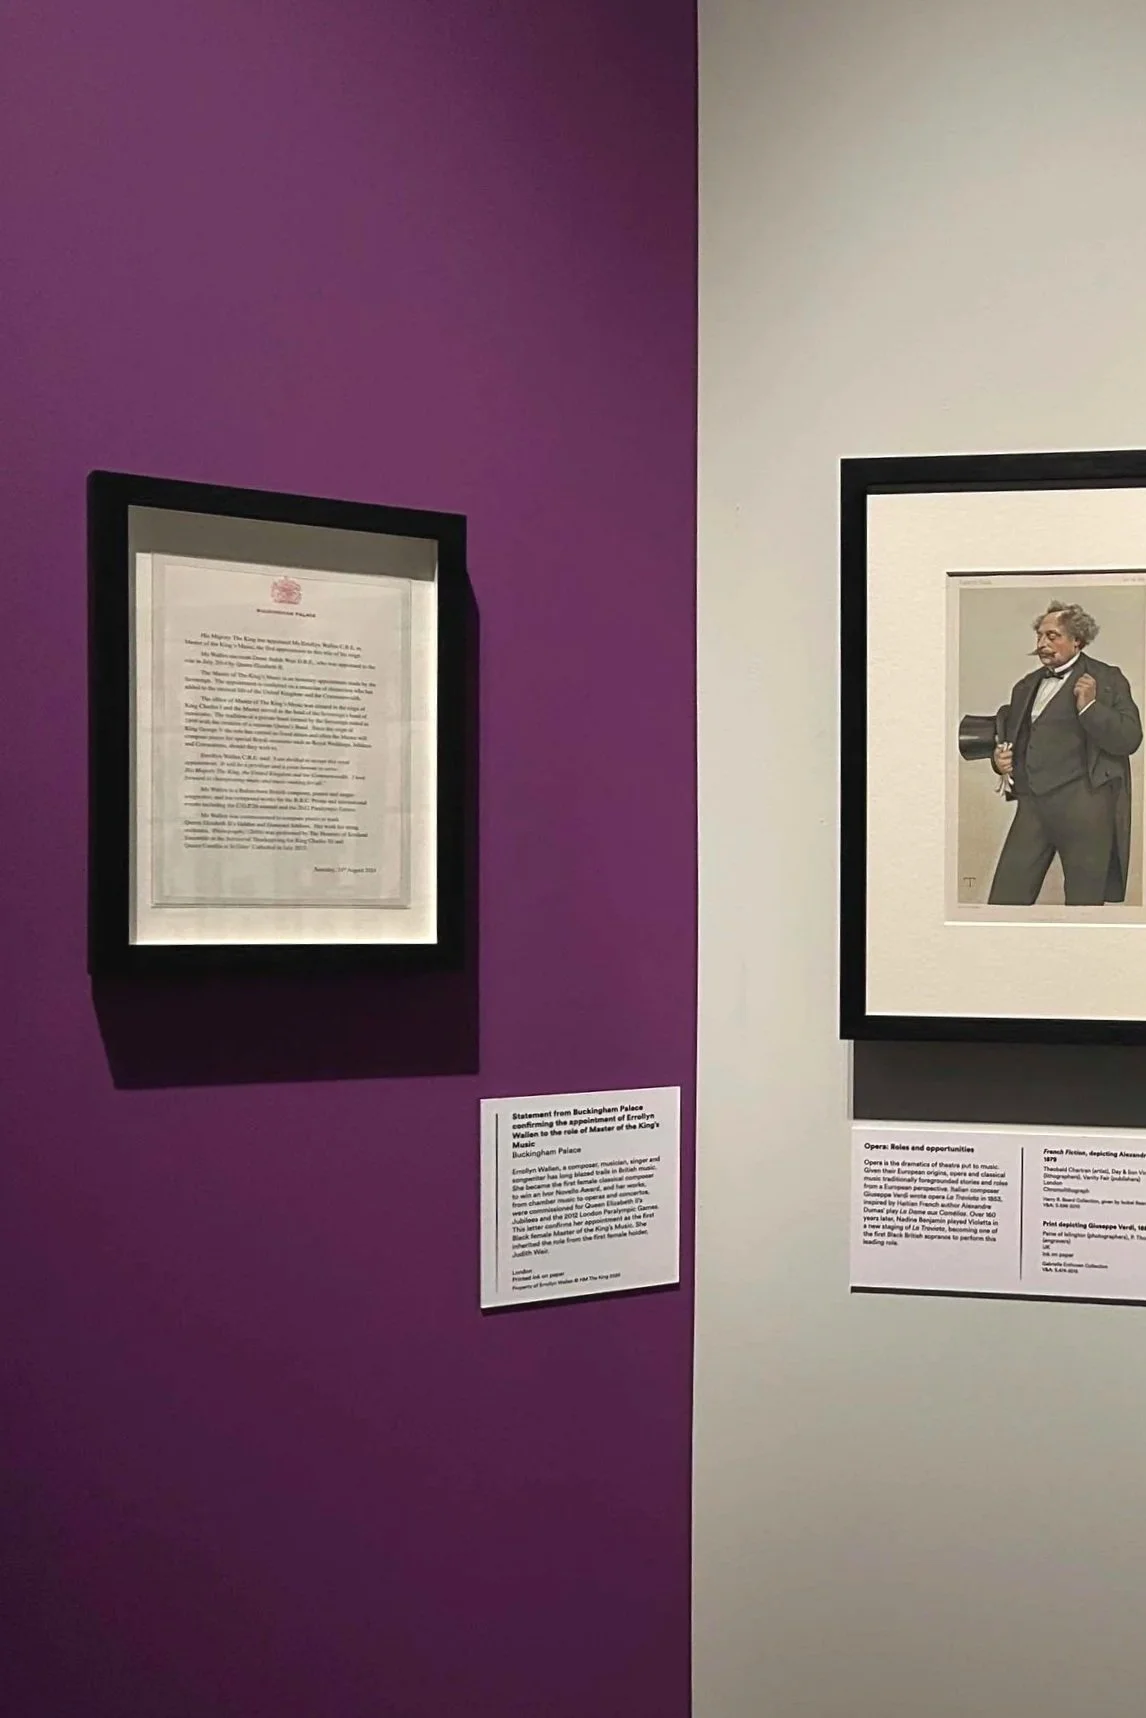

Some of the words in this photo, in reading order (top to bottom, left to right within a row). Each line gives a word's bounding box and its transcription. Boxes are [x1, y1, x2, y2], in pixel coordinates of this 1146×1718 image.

[512, 1110, 551, 1119] Statement
[572, 1106, 618, 1117] Buckingham
[619, 1104, 643, 1112] Palace
[512, 1120, 553, 1131] confirming
[568, 1115, 616, 1127] appointment
[626, 1113, 654, 1122] Errollyn
[512, 1130, 538, 1139] Wallen
[549, 1128, 562, 1136] the
[563, 1127, 578, 1135] role
[588, 1125, 614, 1133] Master
[512, 1140, 535, 1148] Music
[864, 1143, 888, 1151] Opera:
[926, 1145, 974, 1153] opportunities
